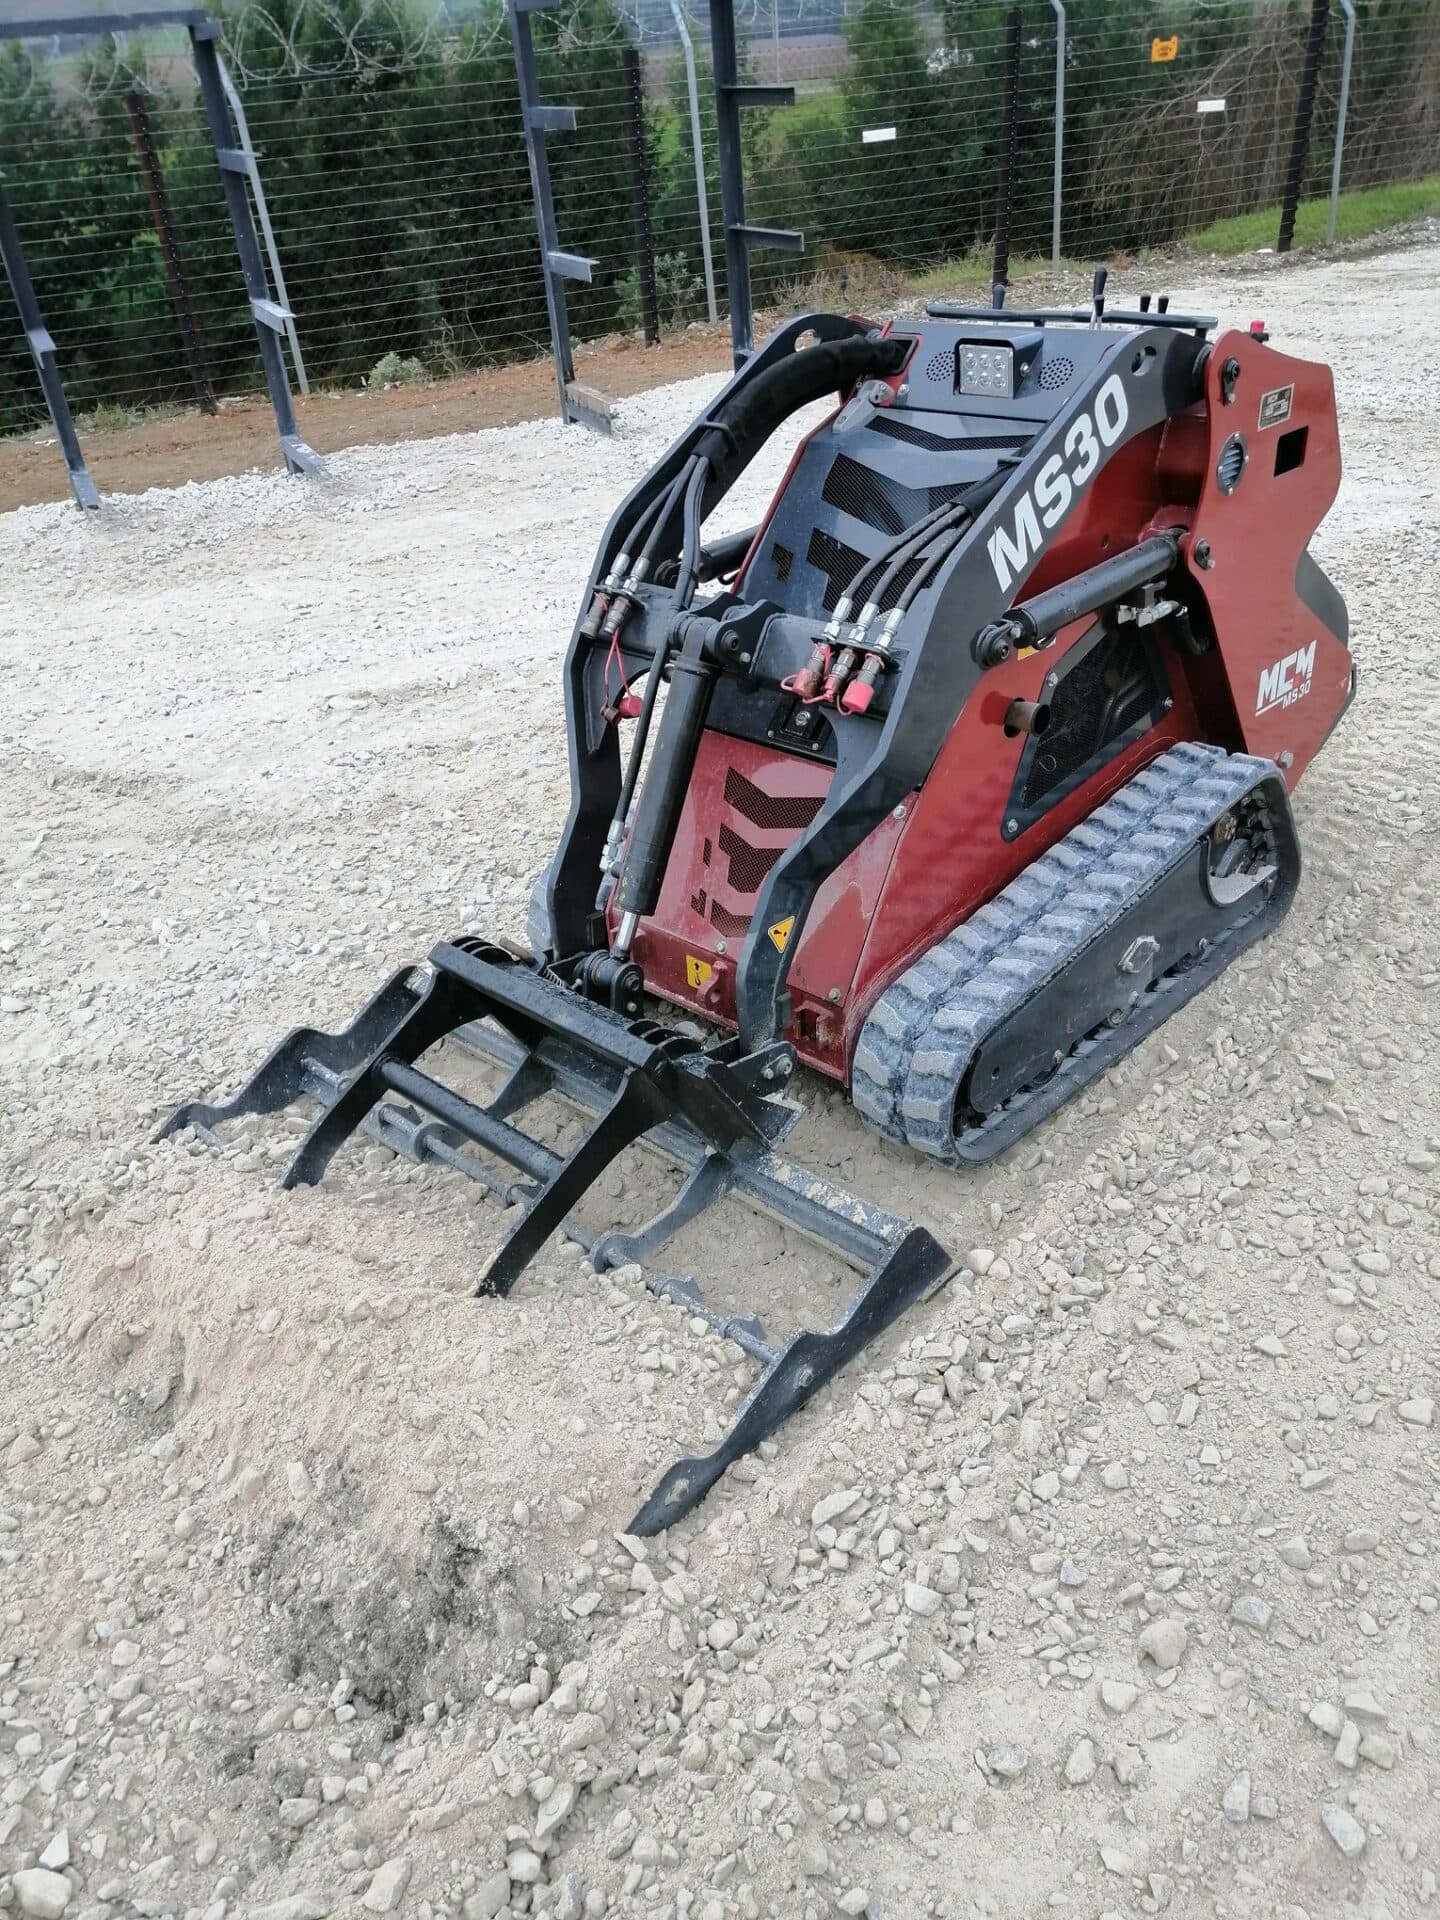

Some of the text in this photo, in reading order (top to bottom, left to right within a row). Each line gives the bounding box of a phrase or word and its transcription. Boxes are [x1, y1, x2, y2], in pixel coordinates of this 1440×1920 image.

[987, 374, 1128, 593] MS30
[1256, 640, 1317, 711] MCM
[1282, 680, 1311, 709] MS30
